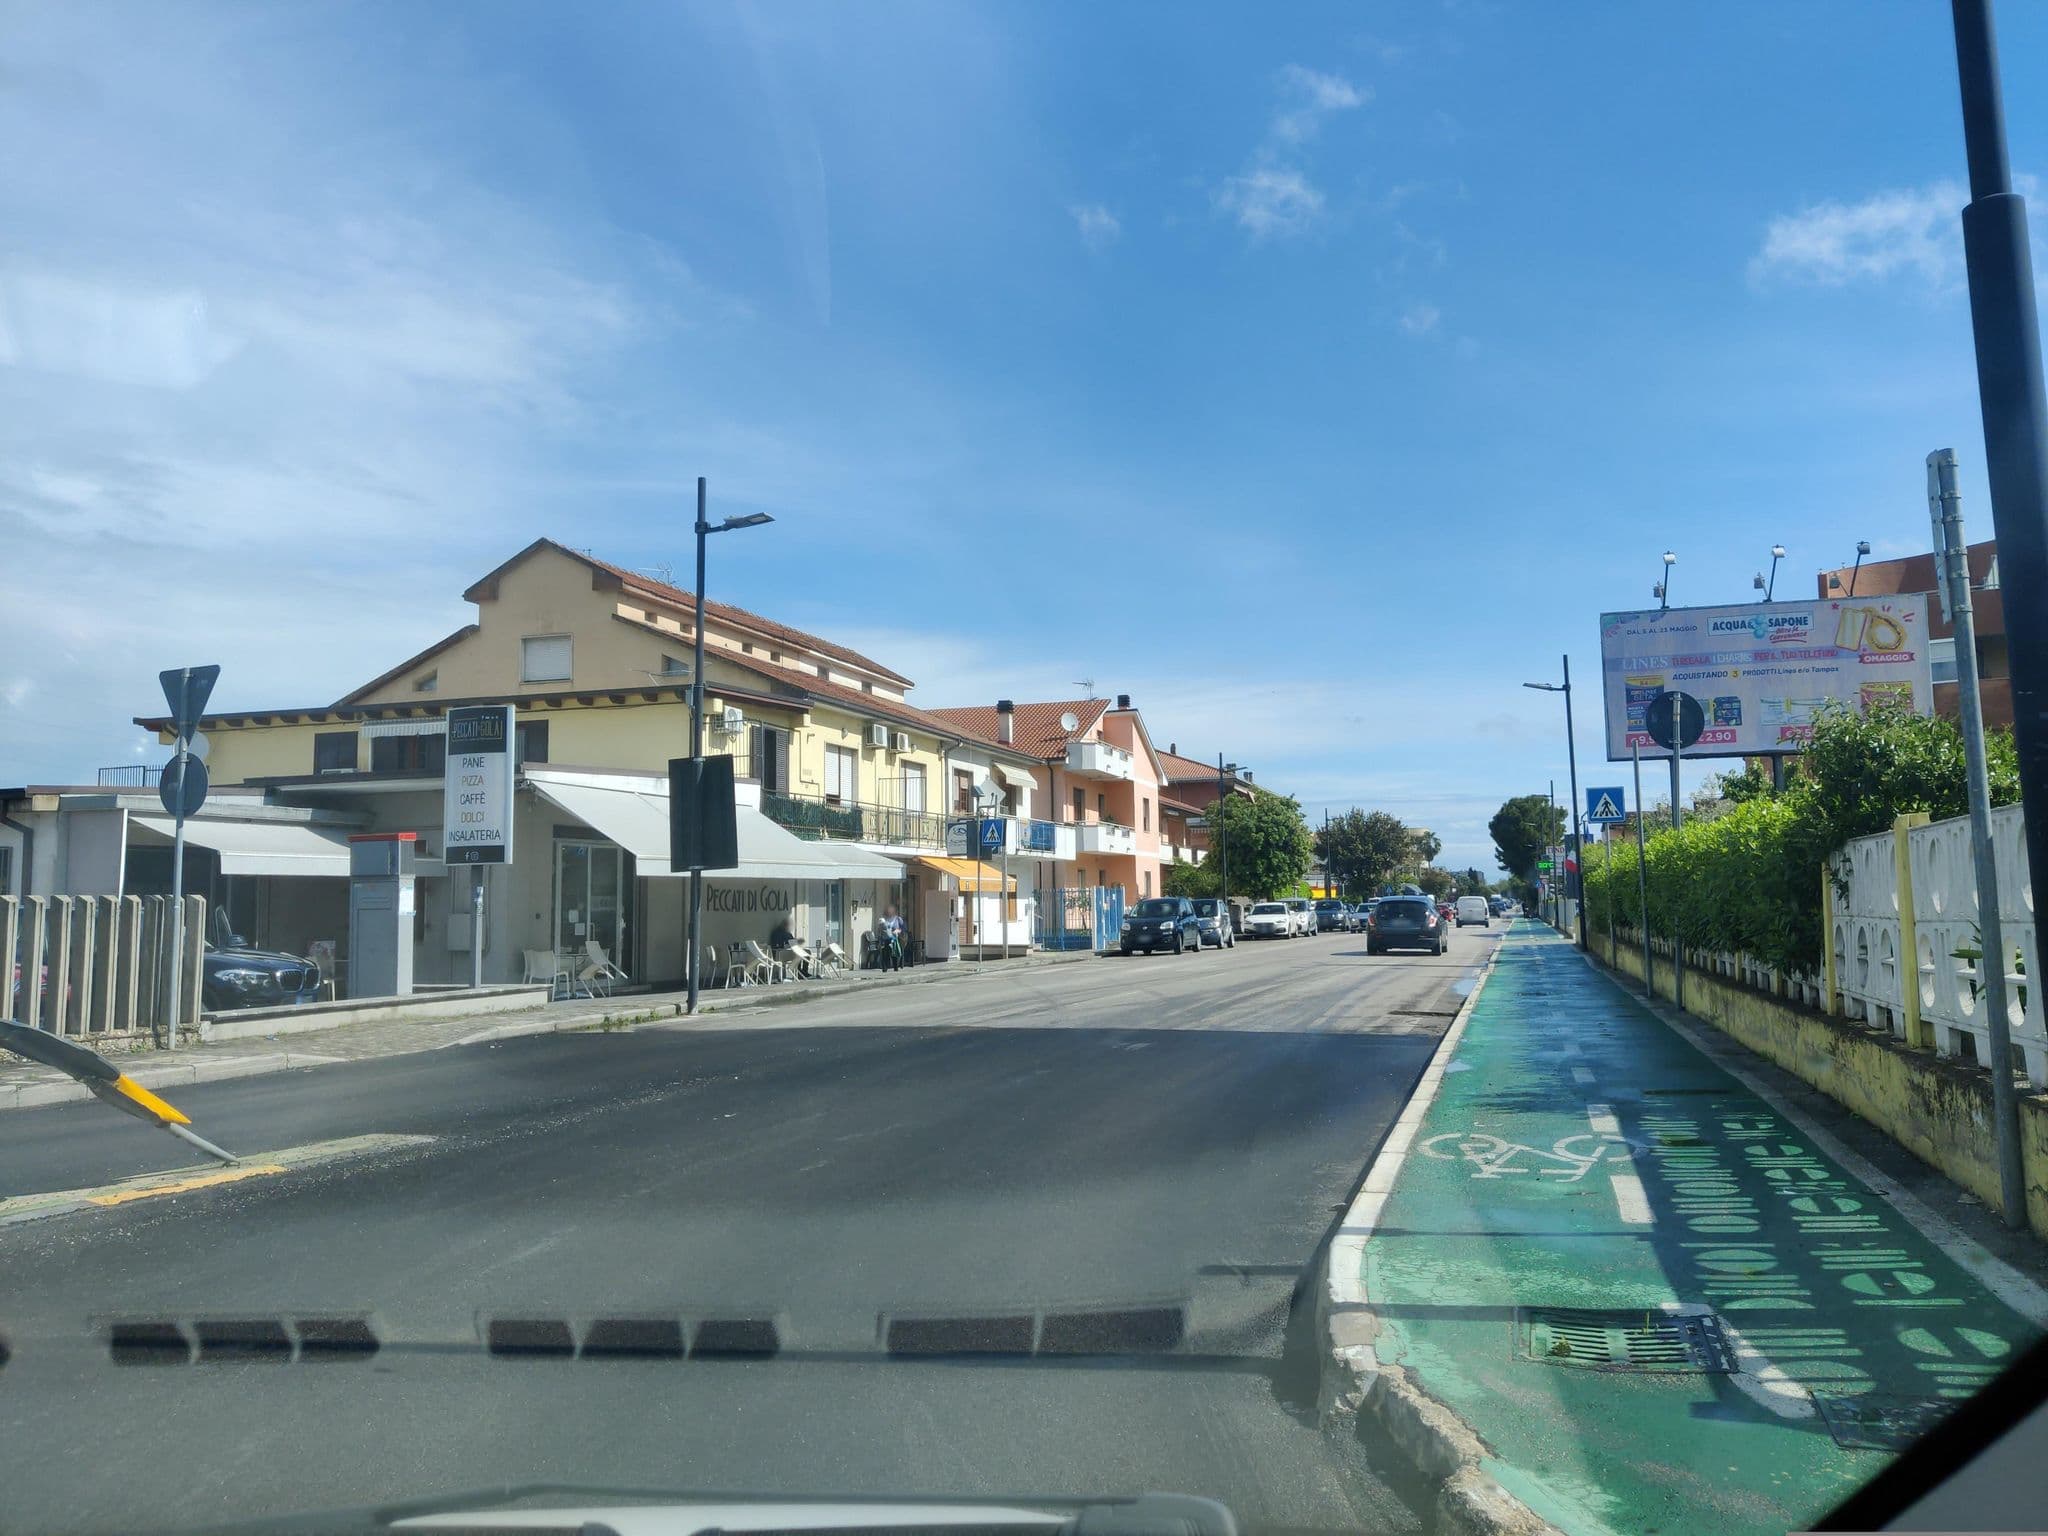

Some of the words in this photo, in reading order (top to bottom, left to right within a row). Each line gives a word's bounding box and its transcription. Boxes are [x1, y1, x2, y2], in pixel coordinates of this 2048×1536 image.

[1767, 616, 1809, 628] SAPONE
[1669, 625, 1698, 633] MAGGIO
[1622, 657, 1668, 671] LINES
[1863, 654, 1910, 663] OMAGGIO
[1672, 670, 1728, 681] ACQUISTANDO
[1732, 670, 1738, 678] 3
[1742, 668, 1777, 677] PRODOTTI
[1777, 667, 1796, 675] Lines
[1798, 666, 1809, 674] e/o
[1811, 665, 1839, 674] Tampax
[453, 720, 478, 738] PECCATI
[480, 719, 500, 737] GOLA
[462, 756, 486, 769] PANE
[461, 775, 485, 787] PIZZA
[459, 791, 486, 805] CAFFÈ
[460, 811, 485, 823] DOLCI
[448, 829, 501, 842] INSALATERIA
